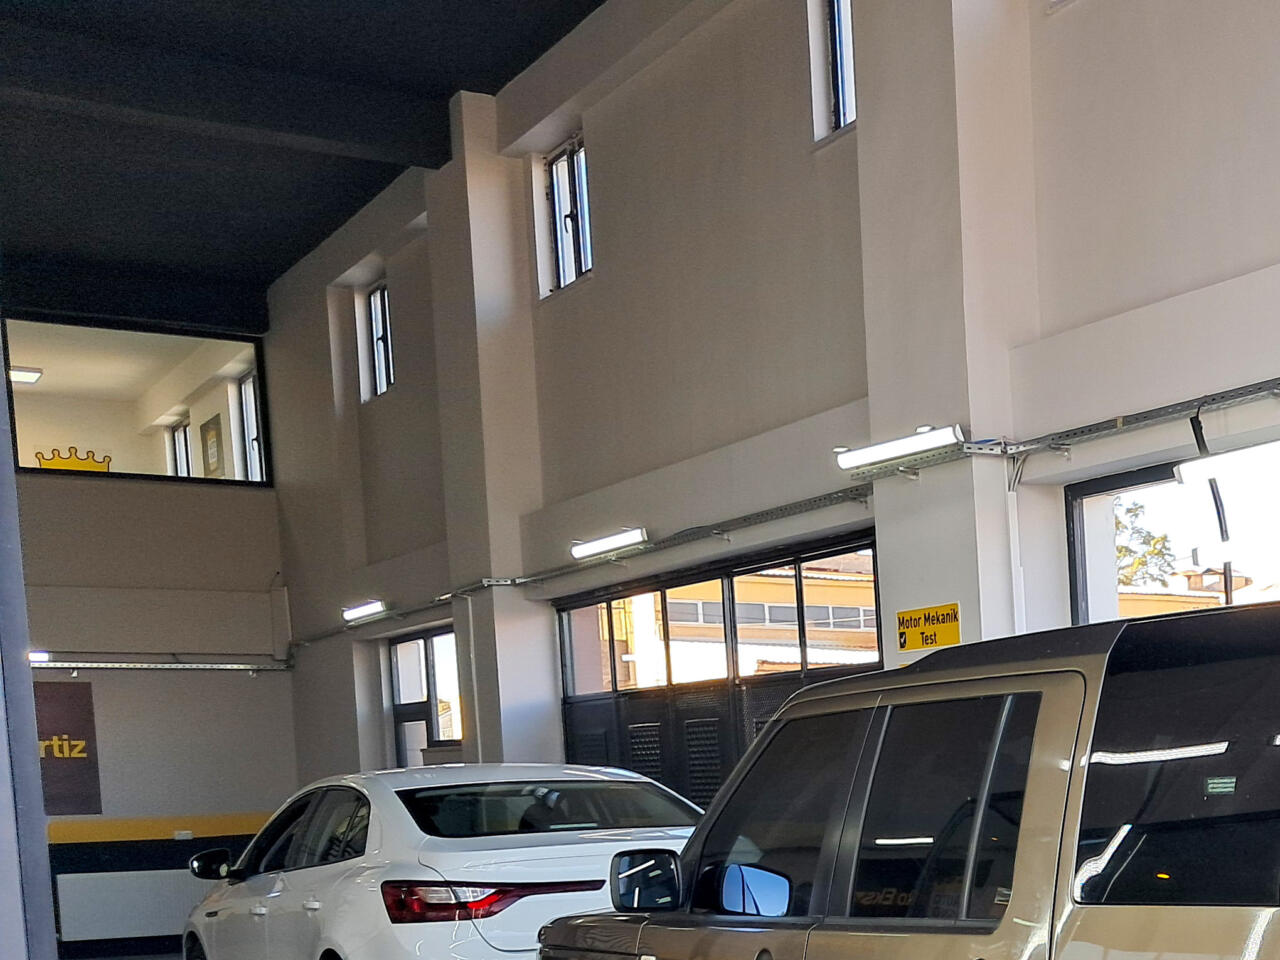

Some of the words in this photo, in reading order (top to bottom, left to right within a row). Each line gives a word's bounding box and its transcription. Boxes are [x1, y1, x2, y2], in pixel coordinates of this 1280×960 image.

[898, 616, 921, 630] Motor
[924, 608, 959, 627] Mekanik
[920, 632, 937, 646] Test
